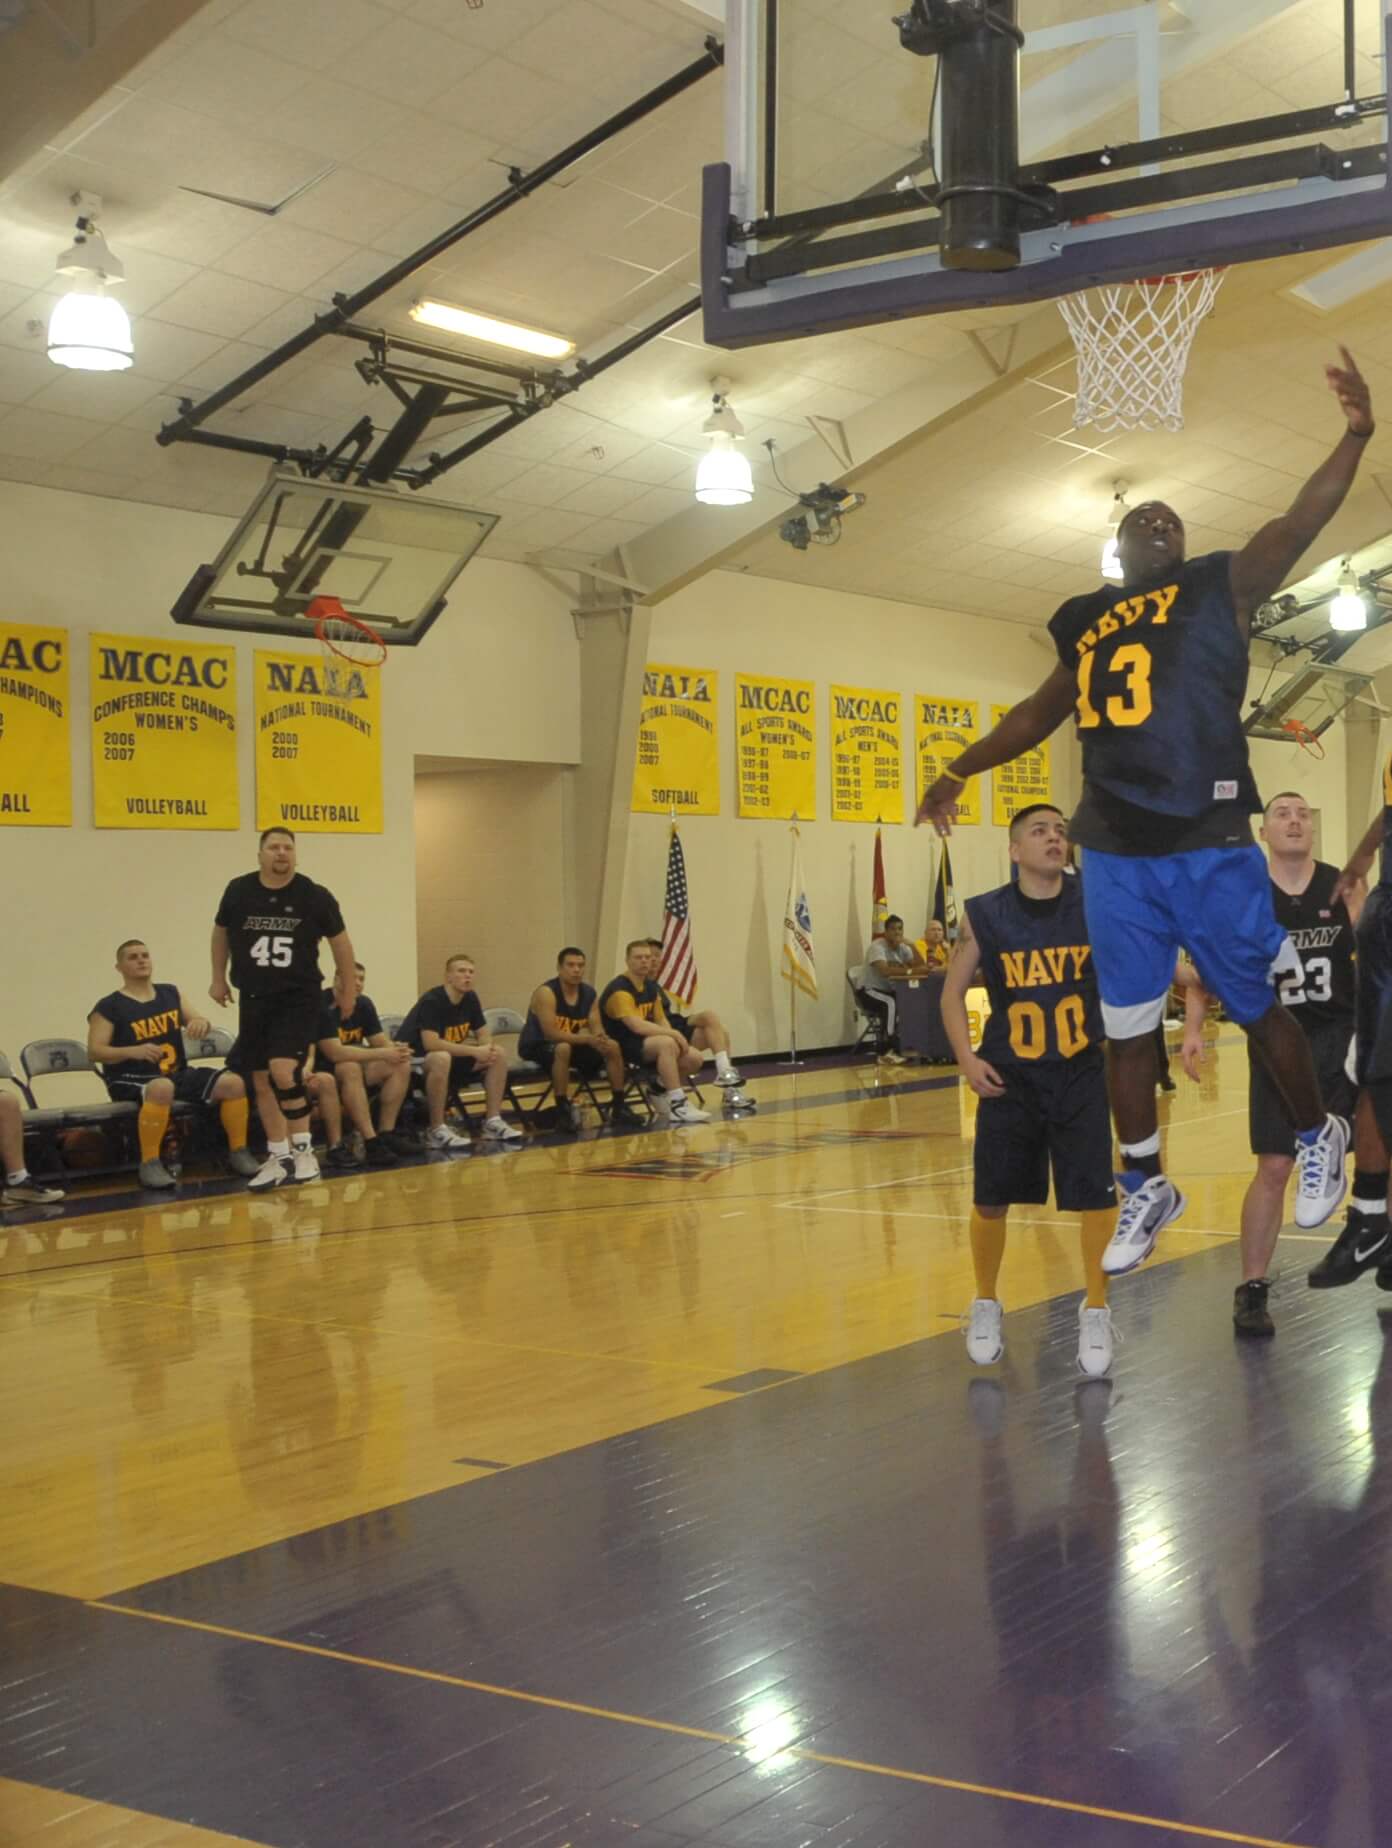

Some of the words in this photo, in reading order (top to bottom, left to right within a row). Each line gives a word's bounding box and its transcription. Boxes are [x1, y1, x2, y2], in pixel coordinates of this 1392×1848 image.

[99, 647, 228, 689] MCAC
[266, 661, 368, 698] NAIA
[0, 676, 62, 718] HAMPIONS
[643, 672, 711, 702] NAIA
[740, 684, 810, 714] MCAC
[1076, 642, 1152, 728] 13
[94, 691, 175, 722] CONFERENCE
[182, 695, 235, 731] CHAMPS
[134, 712, 198, 731] WOMEN'S
[260, 701, 306, 731] NATIONAL
[311, 701, 372, 737] TOURNAMENT
[757, 716, 784, 729] SPORTS
[834, 695, 897, 724] MCAC
[922, 703, 973, 728] NAIA
[104, 732, 135, 746] 2006
[850, 725, 874, 738] SPORTS
[104, 747, 135, 761] 2007
[272, 747, 298, 759] 2007
[127, 798, 208, 815] VOLLEYBALL
[652, 789, 699, 805] SOFTBALL
[281, 803, 360, 822] VOLLEYBALL
[242, 916, 302, 931] ARMY
[1288, 925, 1342, 950] RMY
[250, 936, 293, 967] 45
[1000, 945, 1092, 988] NAVY
[1280, 957, 1332, 1005] 23
[130, 1009, 178, 1040] NAVY
[1008, 995, 1089, 1060] 00
